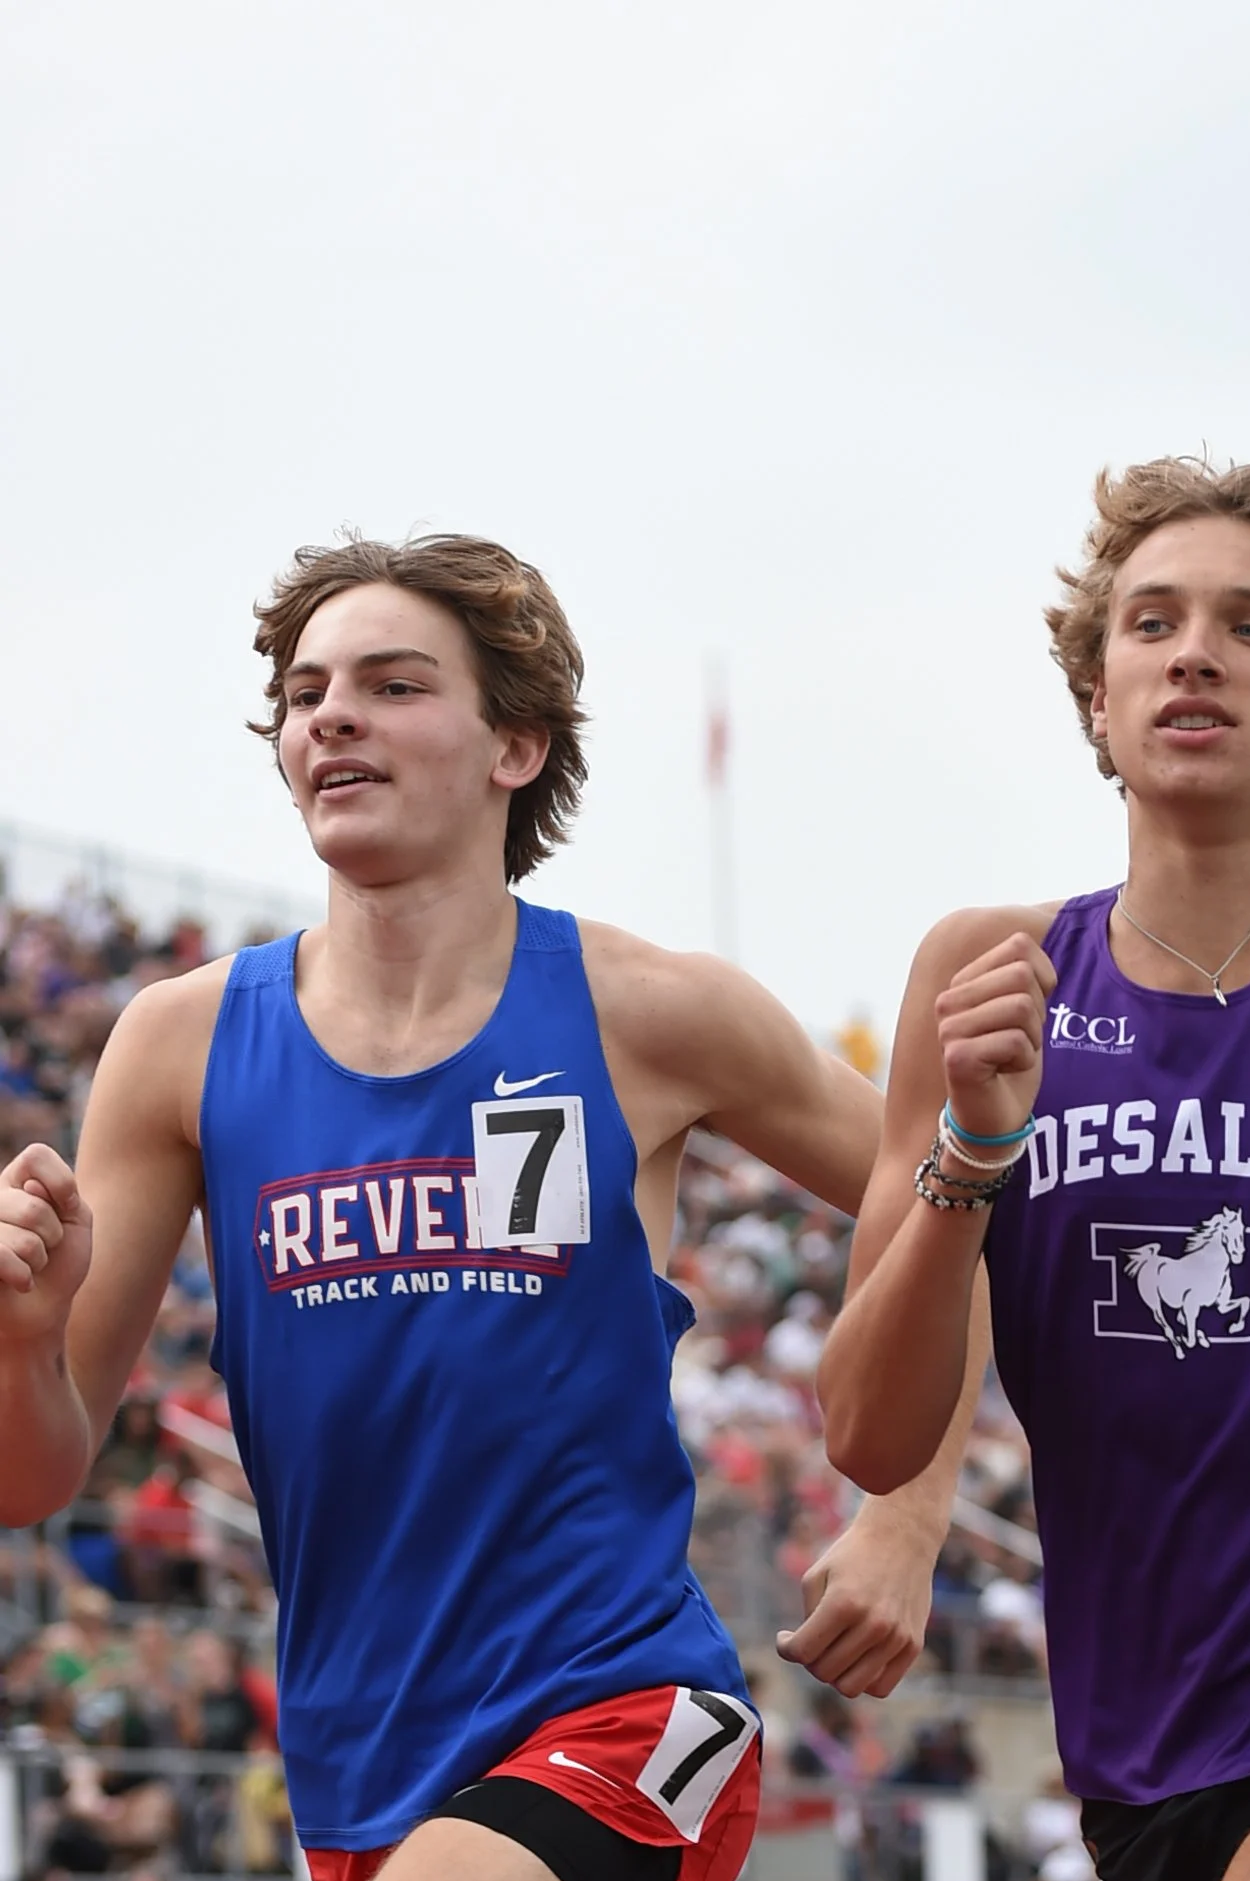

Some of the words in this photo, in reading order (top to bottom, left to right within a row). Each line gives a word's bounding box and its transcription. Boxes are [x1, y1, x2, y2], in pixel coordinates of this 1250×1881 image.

[271, 1175, 560, 1275] REVE
[486, 1108, 566, 1235] 7
[292, 1272, 379, 1309] TRACK
[391, 1271, 450, 1294] AND
[462, 1270, 543, 1296] FIELD
[658, 1690, 747, 1807] 7
